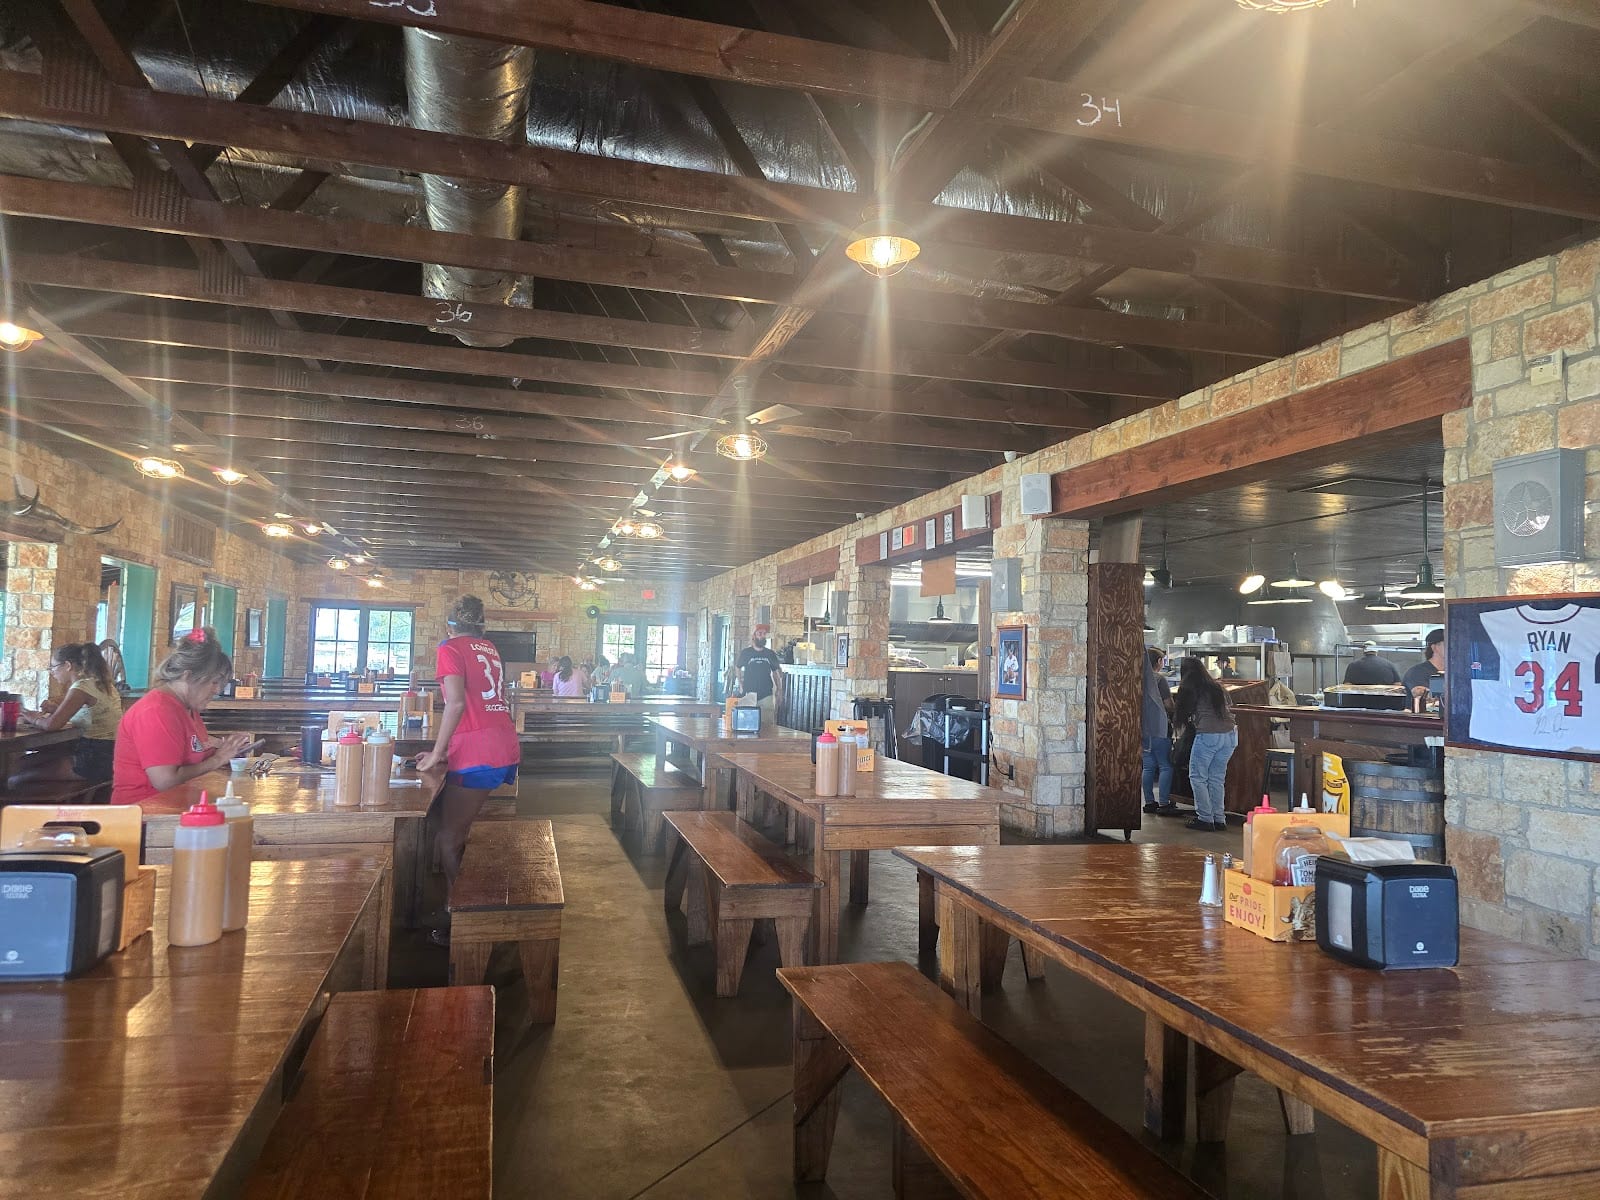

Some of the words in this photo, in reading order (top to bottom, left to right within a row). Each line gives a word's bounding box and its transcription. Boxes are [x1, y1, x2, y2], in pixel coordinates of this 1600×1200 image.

[1076, 92, 1122, 127] 34
[435, 302, 472, 323] 36
[455, 414, 484, 430] 36
[1527, 630, 1571, 653] RYAN
[476, 654, 504, 702] 37
[1514, 660, 1582, 717] 34
